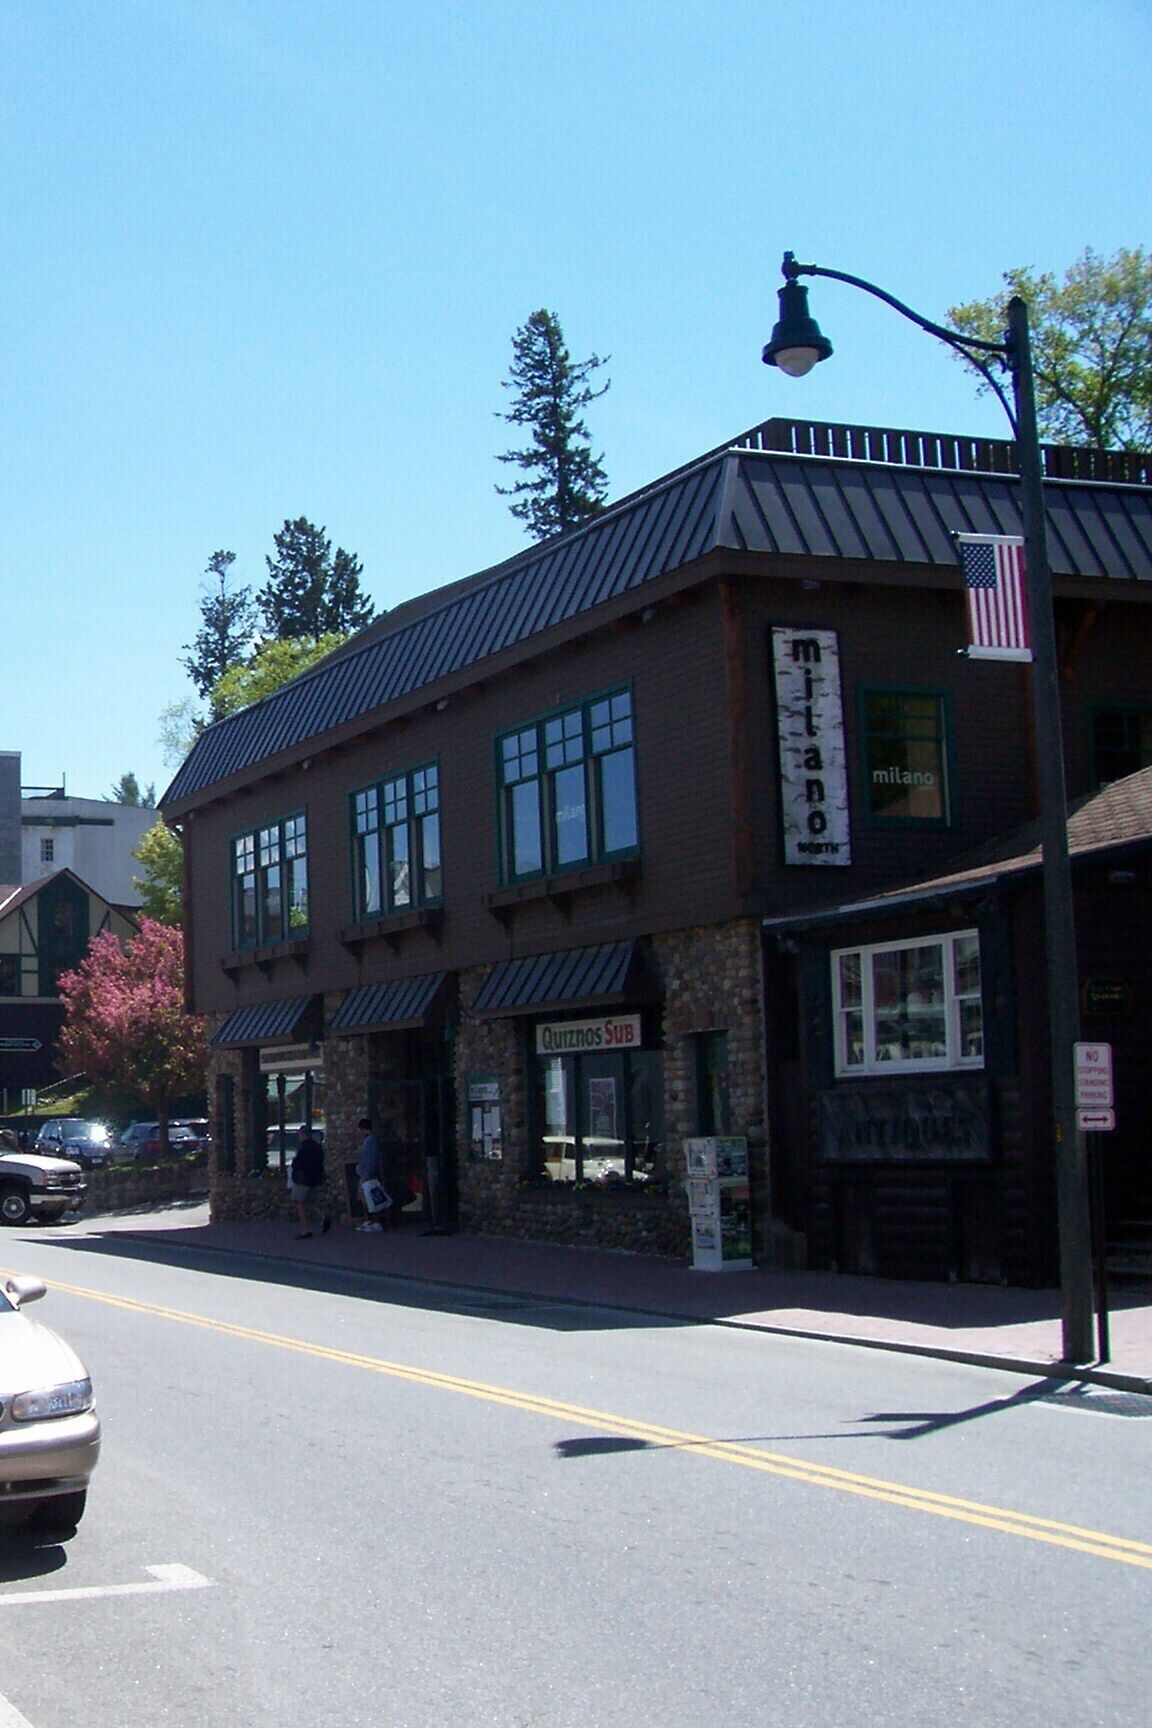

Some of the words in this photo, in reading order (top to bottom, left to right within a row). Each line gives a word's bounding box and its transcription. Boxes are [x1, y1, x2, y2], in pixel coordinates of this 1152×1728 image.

[792, 637, 827, 835] milano
[872, 766, 935, 785] milano
[1085, 1050, 1099, 1062] NO
[1080, 1090, 1107, 1099] PARKING
